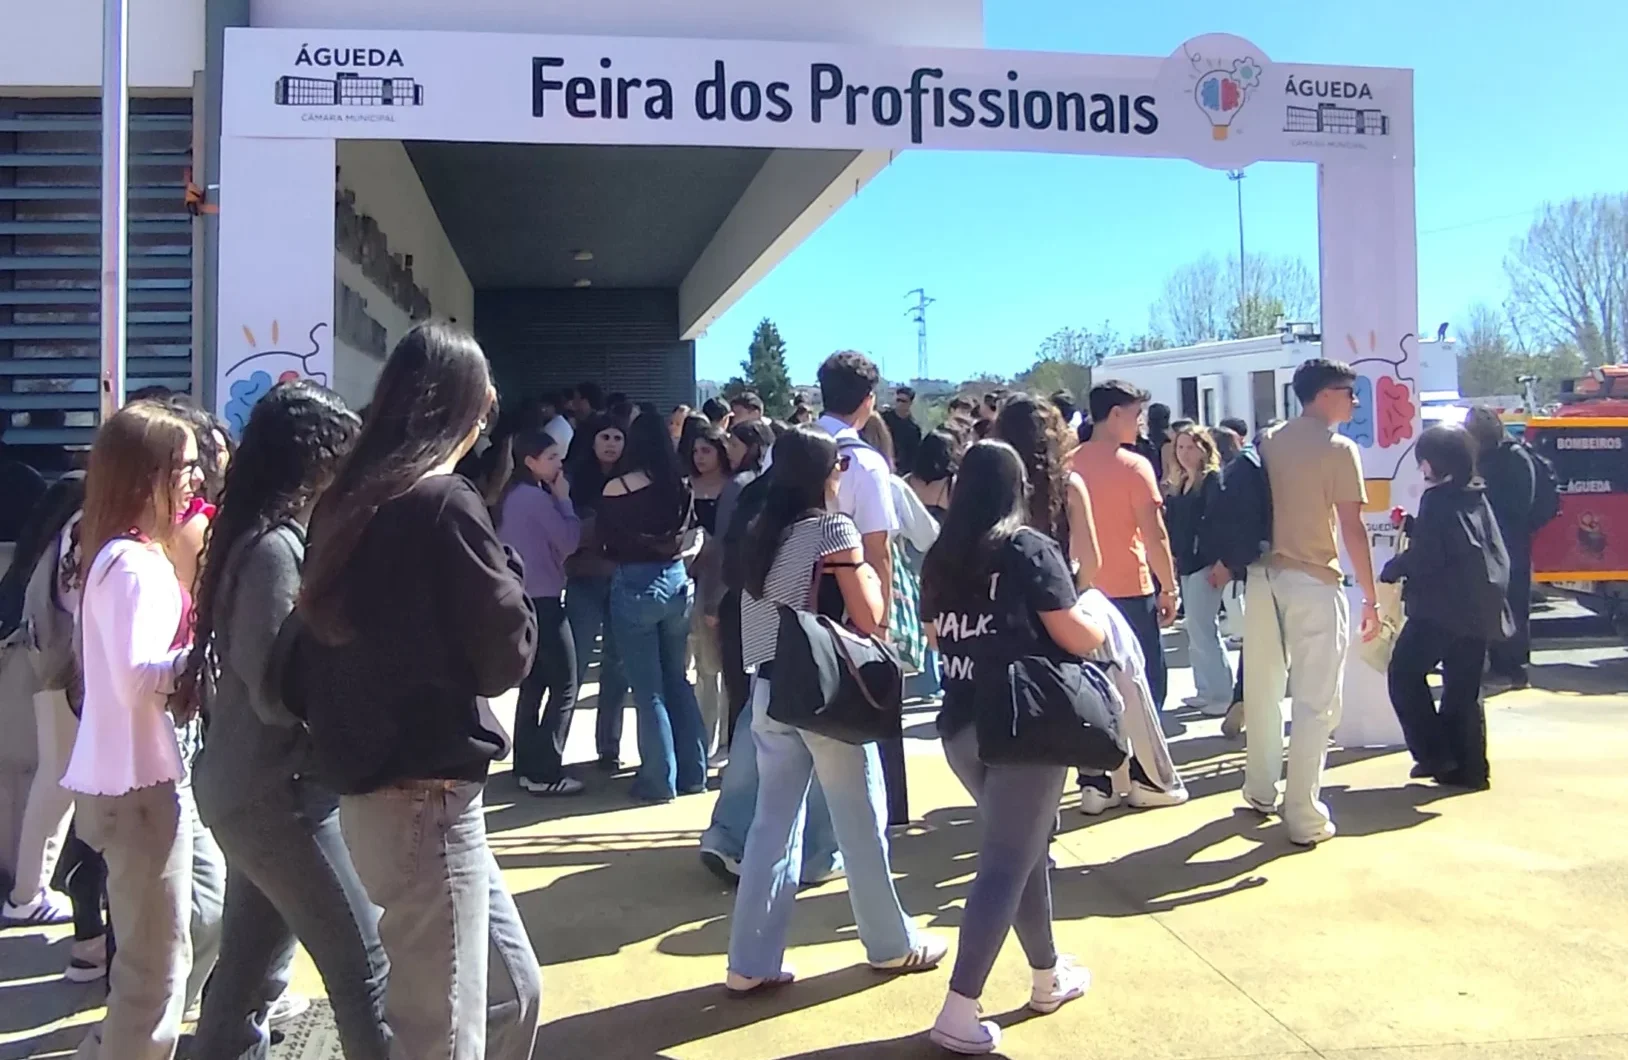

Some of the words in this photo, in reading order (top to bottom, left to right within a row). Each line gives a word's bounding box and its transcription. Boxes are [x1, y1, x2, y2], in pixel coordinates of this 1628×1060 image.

[295, 43, 404, 66] ÁGUEDA
[1285, 75, 1373, 100] ÁGUEDA
[532, 57, 673, 119] Feira
[695, 60, 793, 123] dos
[811, 63, 1159, 144] Profissionais
[1557, 437, 1622, 449] BOMBEIROS
